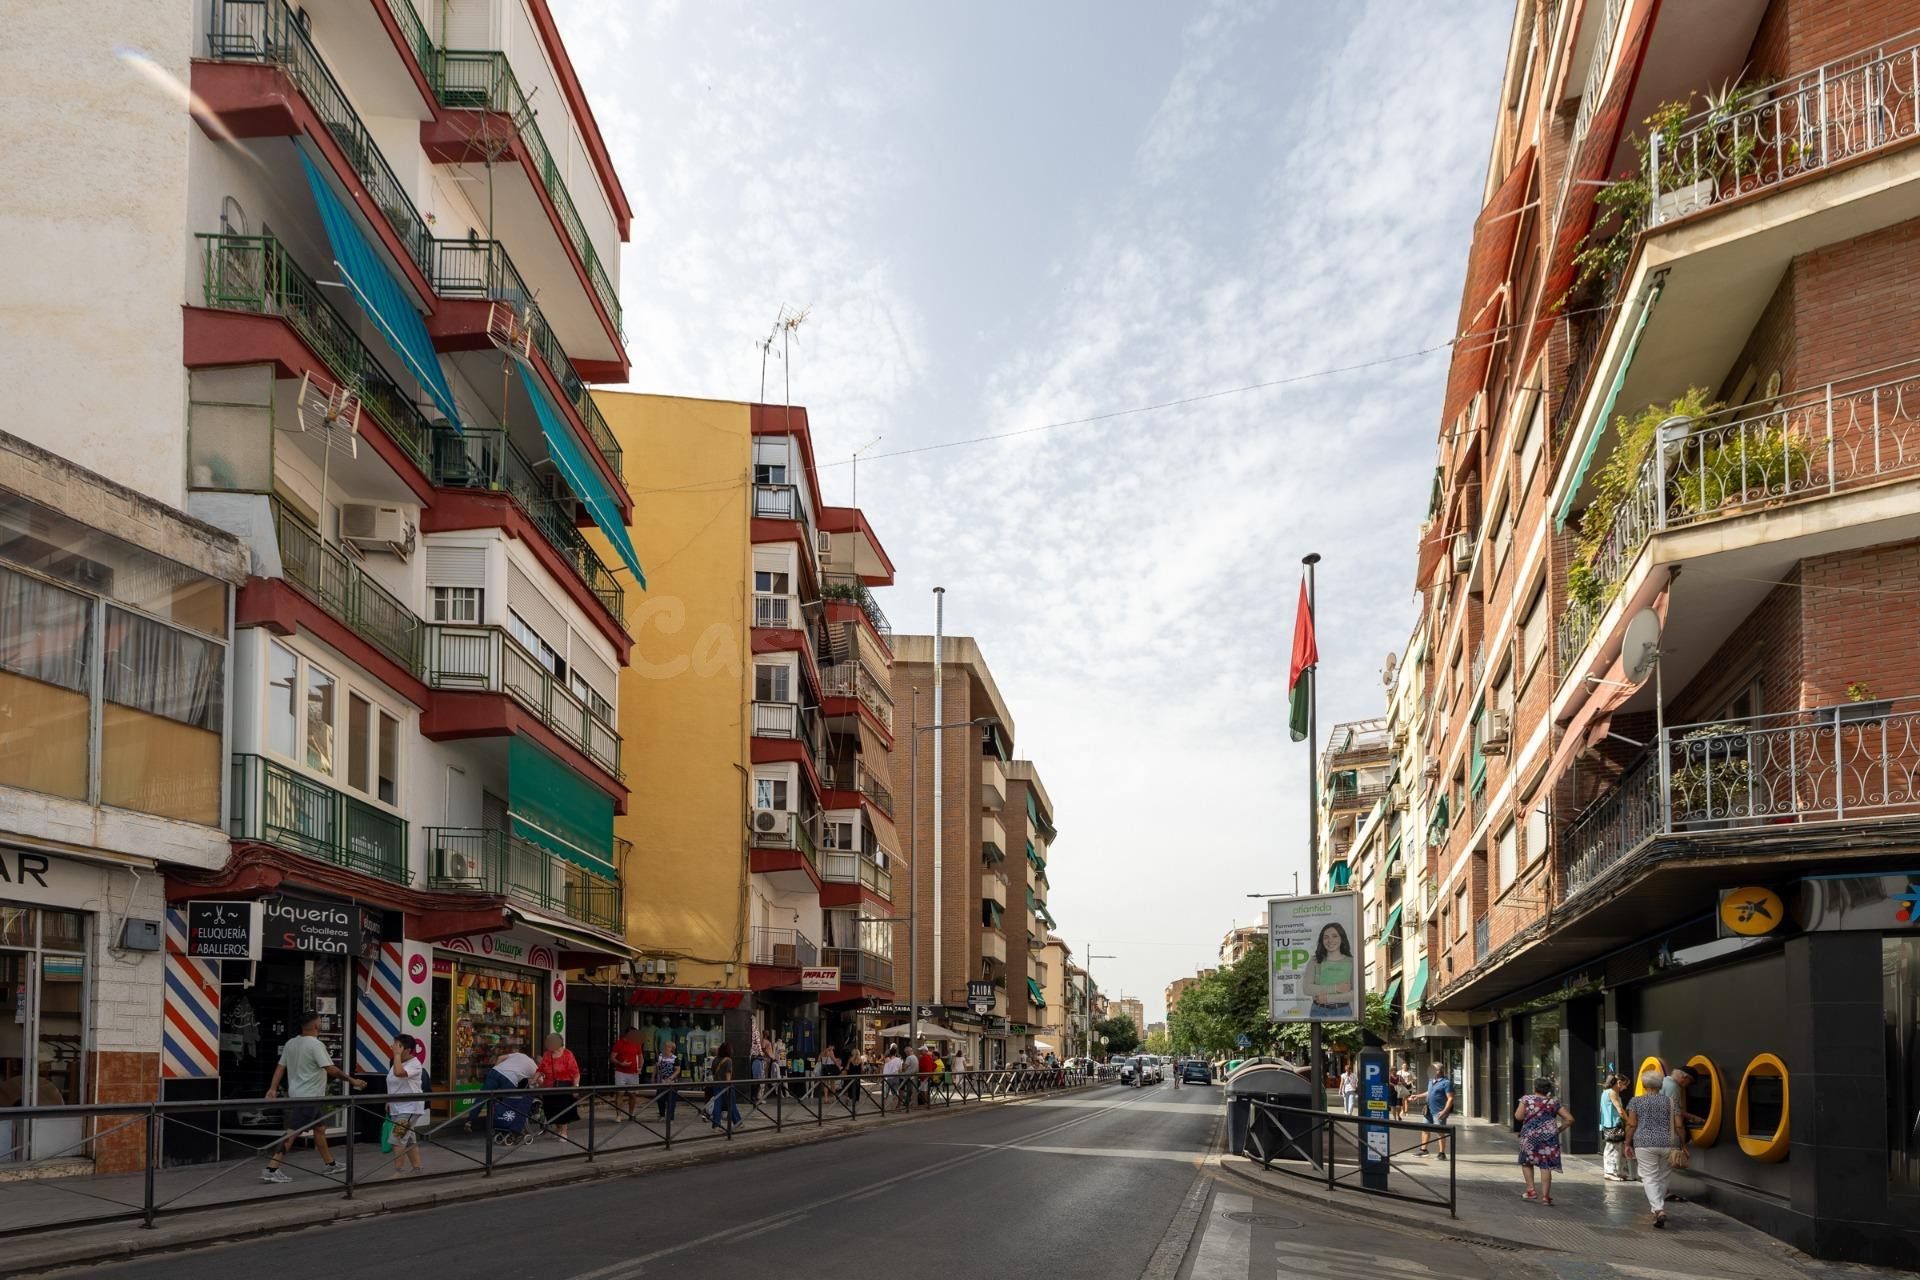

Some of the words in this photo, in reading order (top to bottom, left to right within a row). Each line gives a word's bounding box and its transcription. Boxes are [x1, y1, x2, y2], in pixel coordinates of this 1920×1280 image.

[191, 925, 247, 939] PELUQUERÍA
[300, 924, 349, 937] Caballeros
[191, 943, 247, 955] CABALLEROS
[282, 932, 348, 954] Sultán
[1274, 938, 1290, 948] TU
[1275, 949, 1309, 972] FP
[803, 971, 837, 979] IMPACTO
[972, 984, 991, 995] ZAIDA
[630, 987, 745, 1009] IMPACTO
[1365, 1064, 1381, 1080] P
